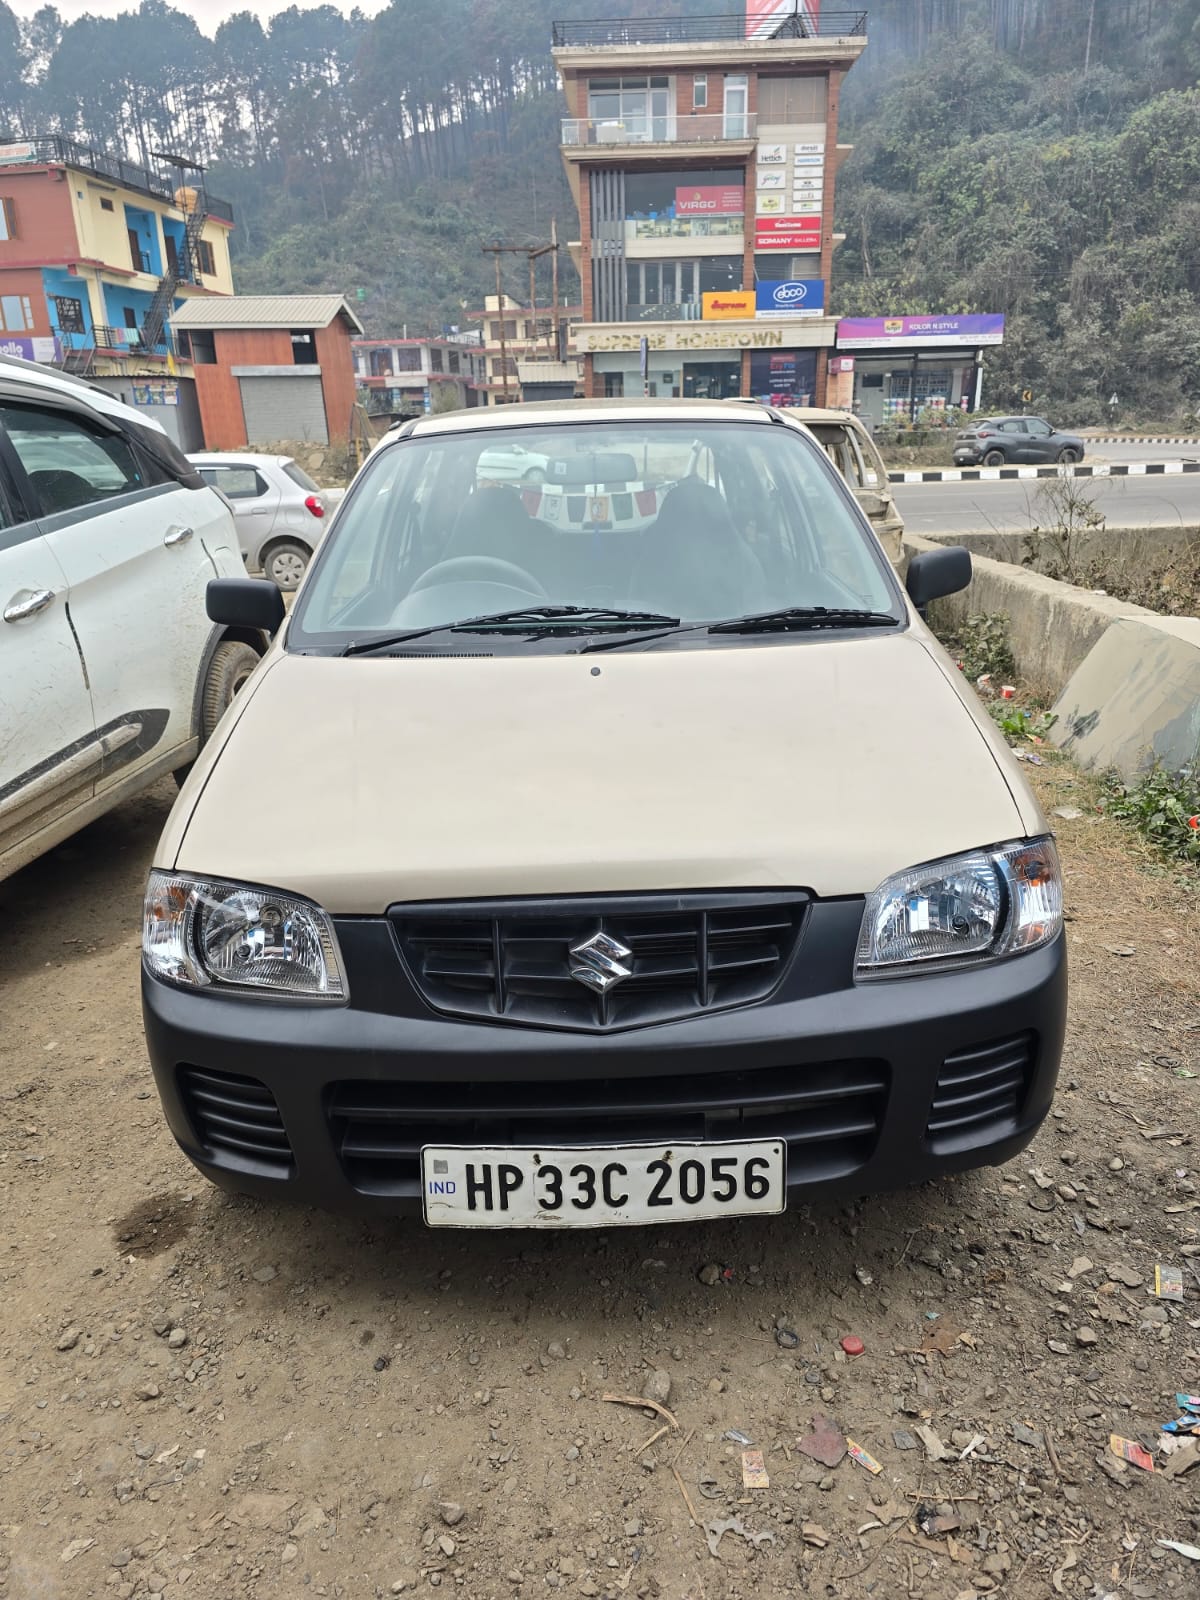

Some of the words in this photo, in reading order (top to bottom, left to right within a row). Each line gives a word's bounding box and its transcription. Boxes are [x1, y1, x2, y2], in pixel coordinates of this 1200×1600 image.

[679, 200, 717, 209] VIRGO
[758, 236, 792, 245] SOMANY
[777, 285, 803, 299] ebco
[676, 330, 783, 348] HOMETOWN
[429, 1181, 456, 1194] IND
[465, 1163, 524, 1211] HP
[537, 1162, 629, 1211] 33C
[646, 1157, 770, 1207] 2056
